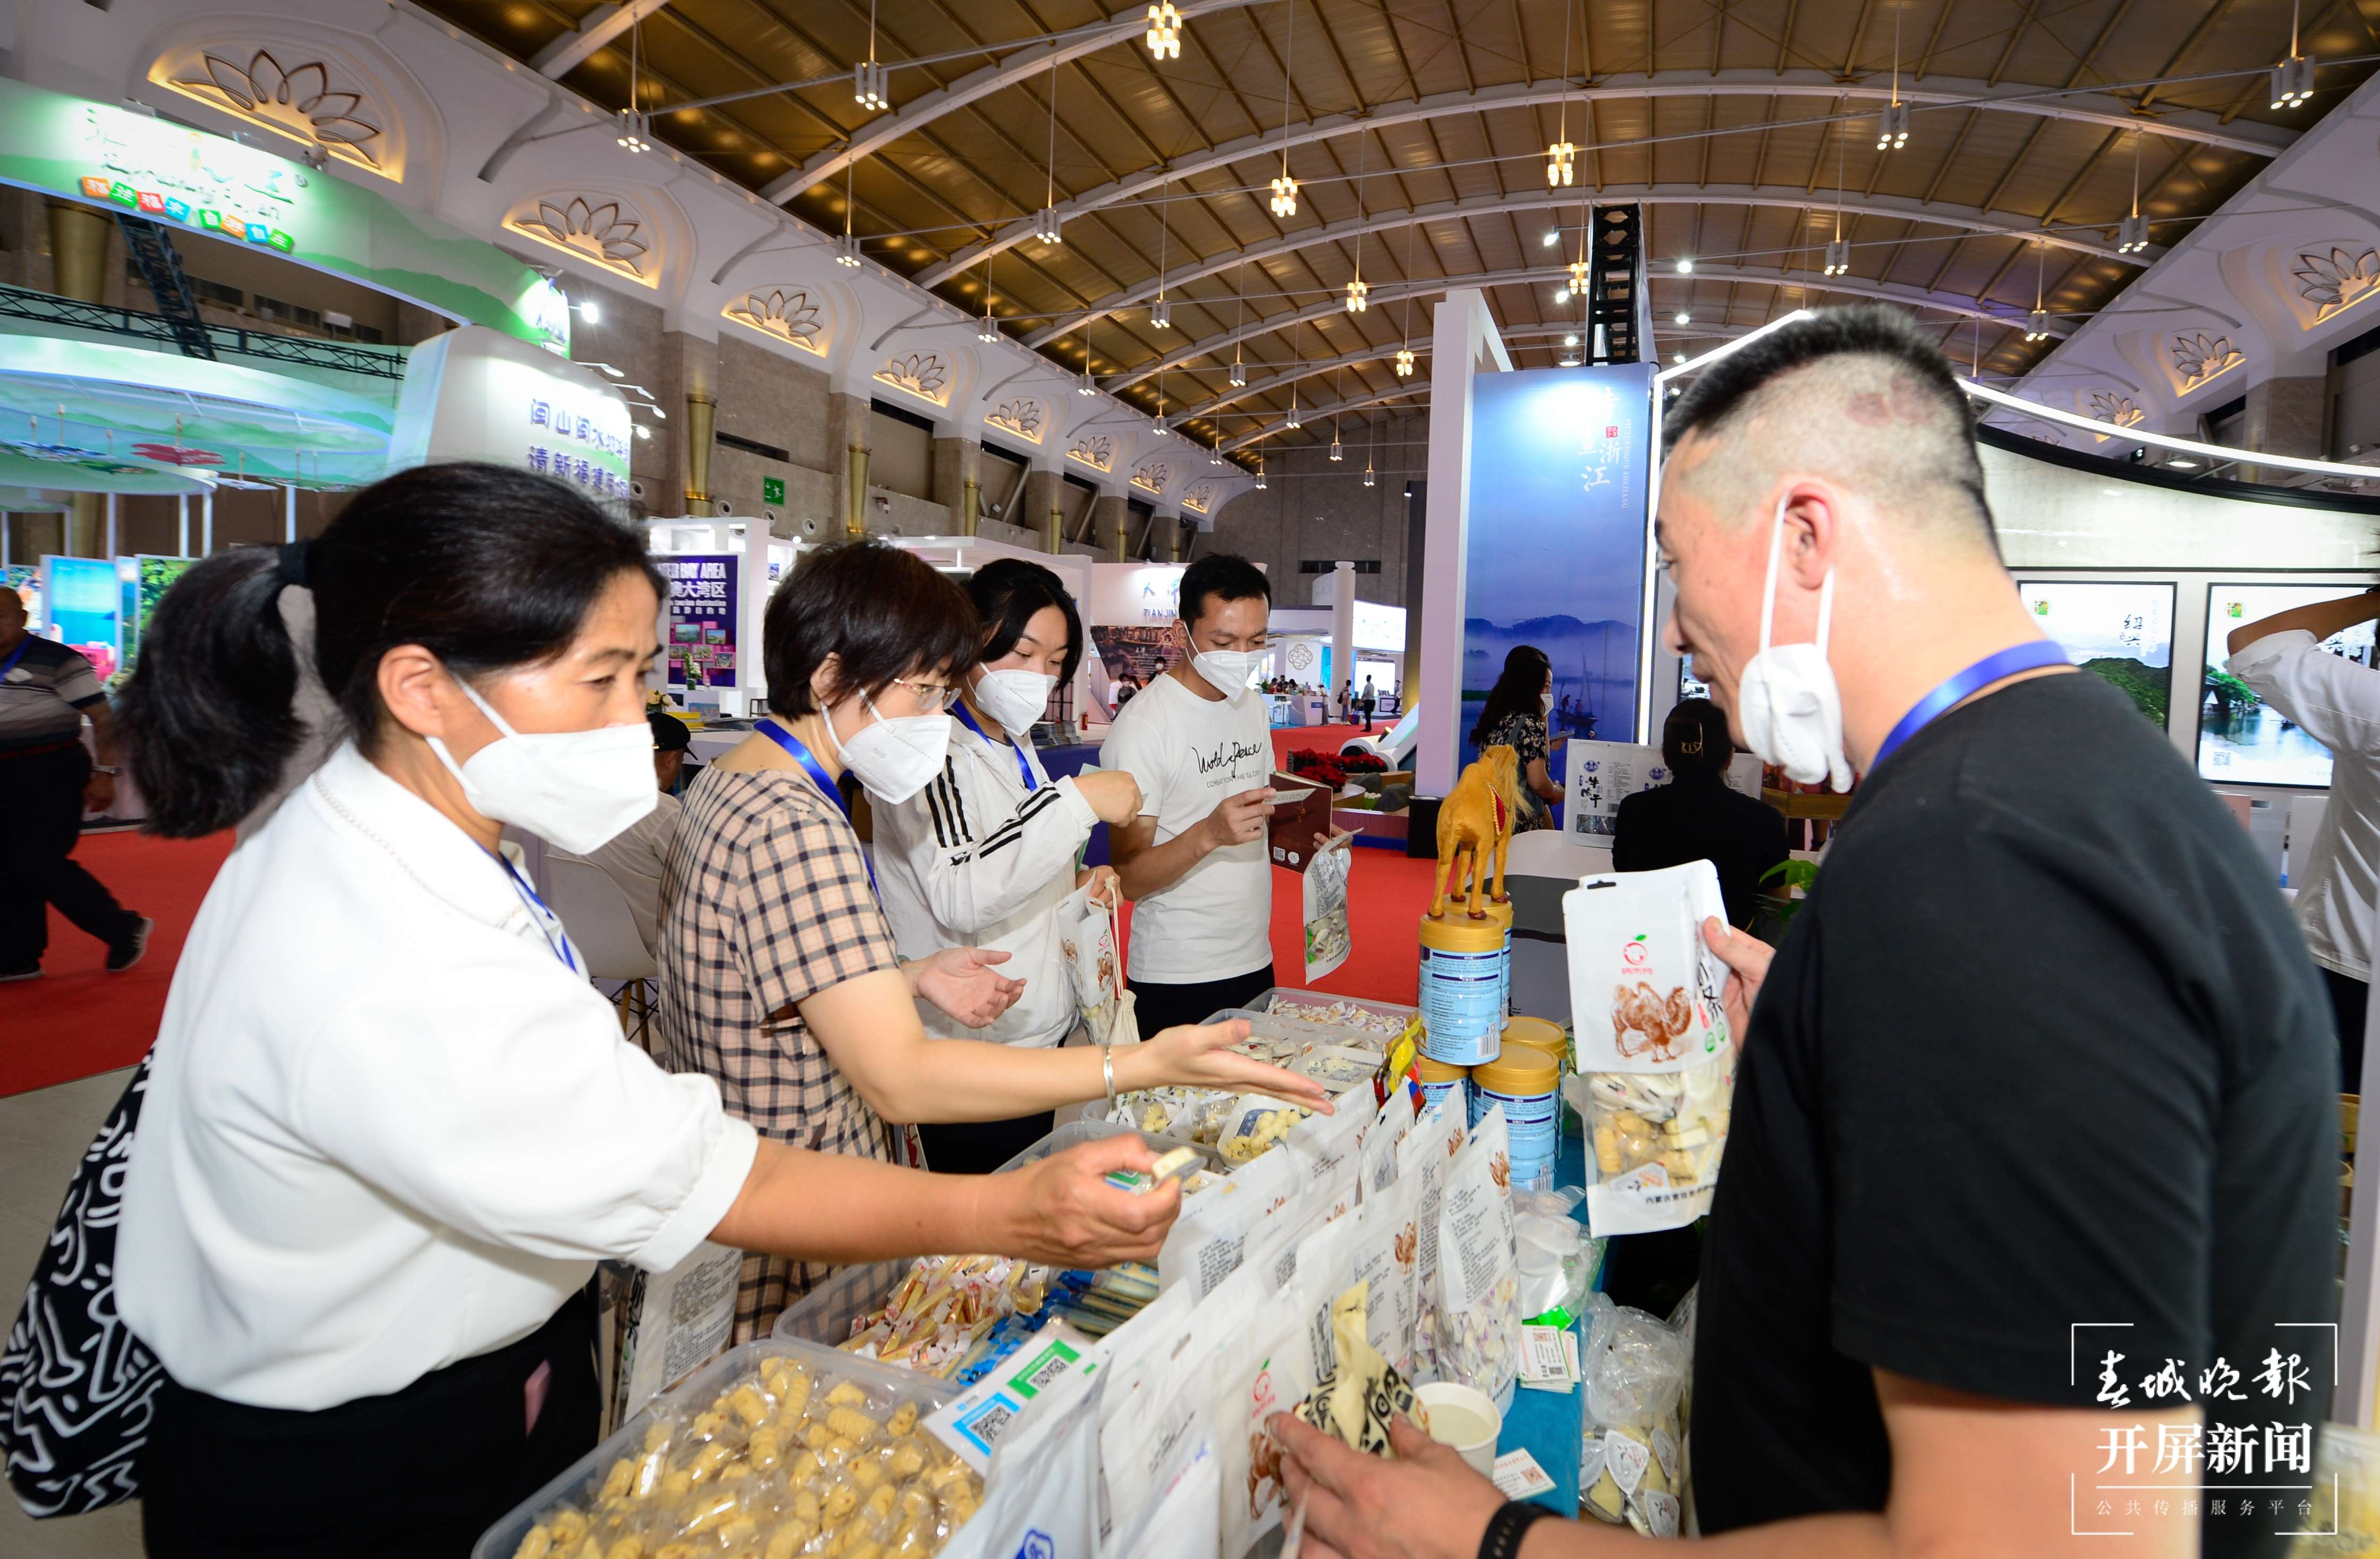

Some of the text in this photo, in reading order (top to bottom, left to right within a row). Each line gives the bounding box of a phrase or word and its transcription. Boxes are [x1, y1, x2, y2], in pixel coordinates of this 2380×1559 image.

[680, 563, 700, 579] BAY
[700, 563, 727, 579] AREA
[1143, 608, 1177, 617] TIANJIN
[2123, 614, 2142, 646] 绍兴
[1234, 773, 1246, 782] THE
